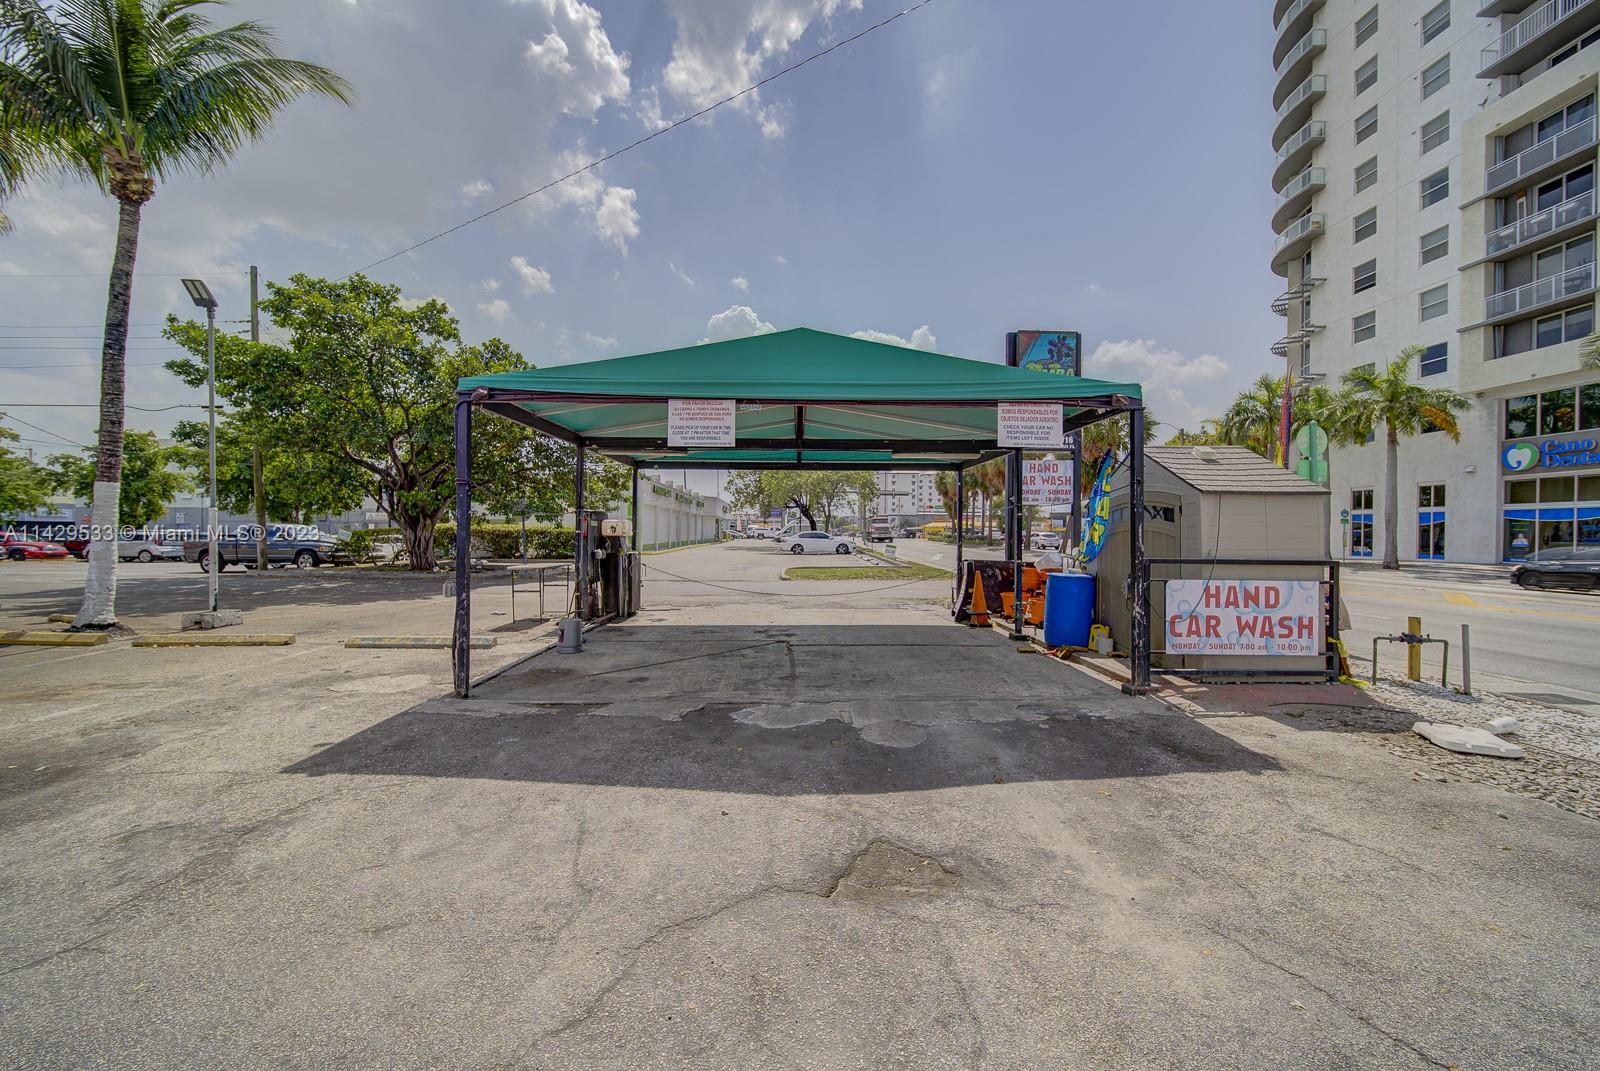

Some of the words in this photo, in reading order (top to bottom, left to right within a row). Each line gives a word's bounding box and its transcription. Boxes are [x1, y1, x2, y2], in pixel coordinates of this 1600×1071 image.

[1541, 439, 1597, 452] Cano
[1029, 464, 1058, 473] HAND
[1022, 476, 1035, 485] AR
[1041, 476, 1071, 486] WASH
[1204, 585, 1280, 608] HAND
[1170, 614, 1221, 638] CAR
[1236, 616, 1314, 639] WASH
